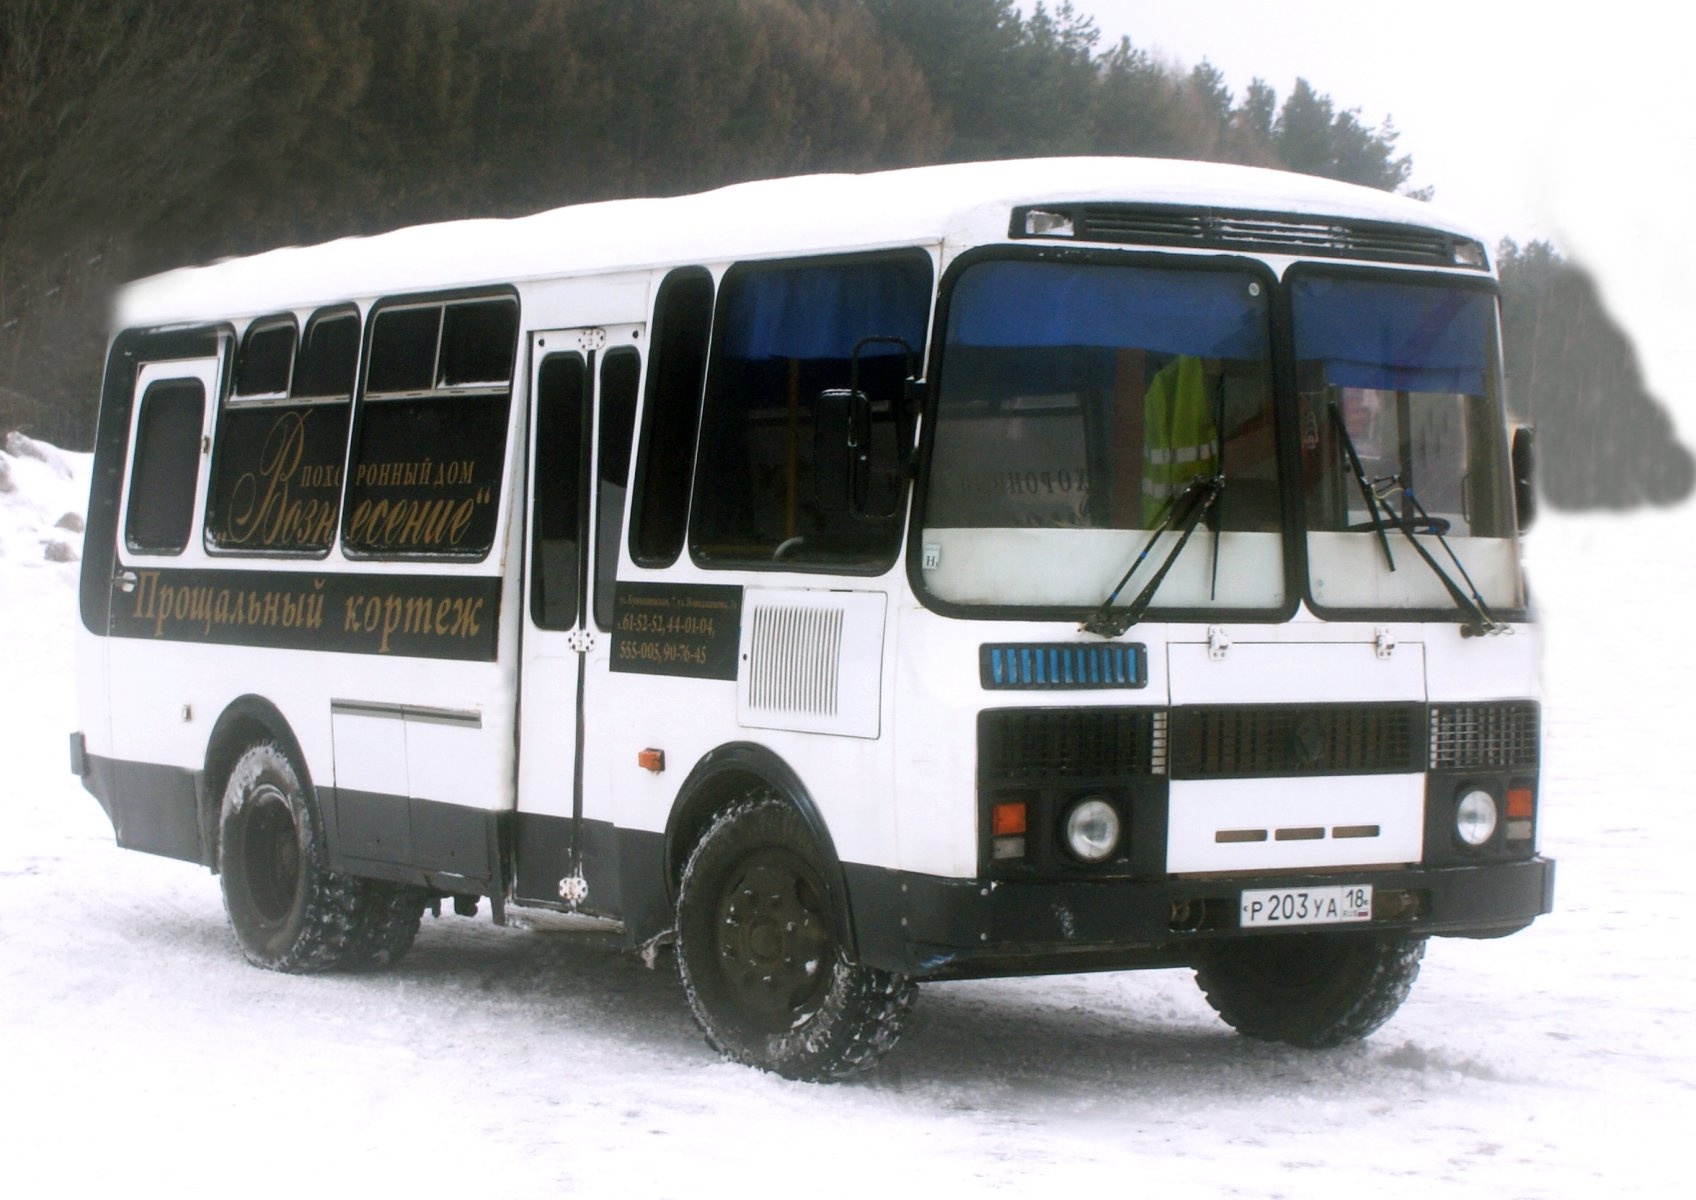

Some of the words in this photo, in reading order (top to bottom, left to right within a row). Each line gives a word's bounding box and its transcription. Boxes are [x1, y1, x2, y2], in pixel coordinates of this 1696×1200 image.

[434, 460, 475, 488] ДОМ
[133, 571, 326, 636] Прощальный
[344, 595, 485, 653] кортеж
